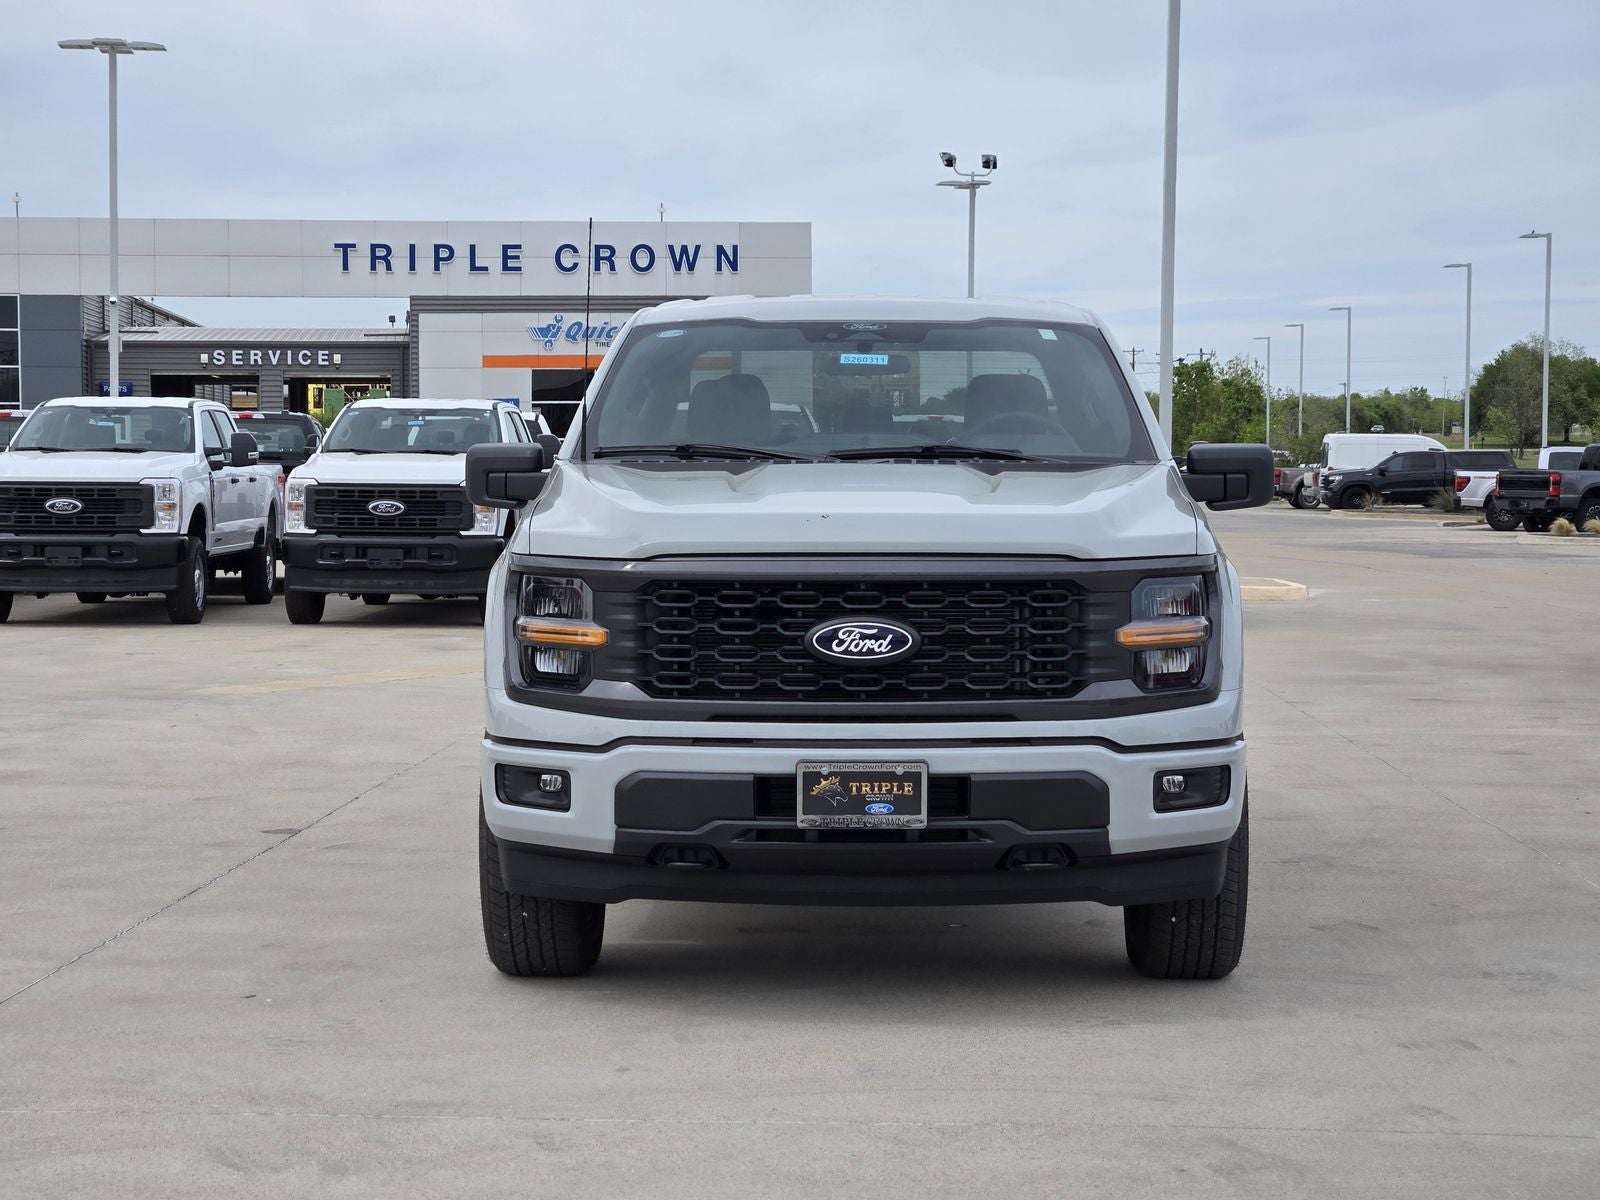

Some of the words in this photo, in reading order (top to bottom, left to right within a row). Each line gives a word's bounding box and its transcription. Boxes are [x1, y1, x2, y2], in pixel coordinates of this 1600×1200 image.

[333, 242, 524, 274] TRIPLE
[553, 243, 740, 274] CROWN
[565, 320, 628, 343] Quic
[212, 349, 330, 366] SERVICE
[843, 356, 885, 364] S260311
[832, 627, 893, 652] Ford
[803, 763, 922, 772] wwwTripleCrownFordcom
[848, 782, 914, 796] TRIPLE
[820, 817, 864, 827] TRIPLE
[865, 817, 905, 827] CROWN
